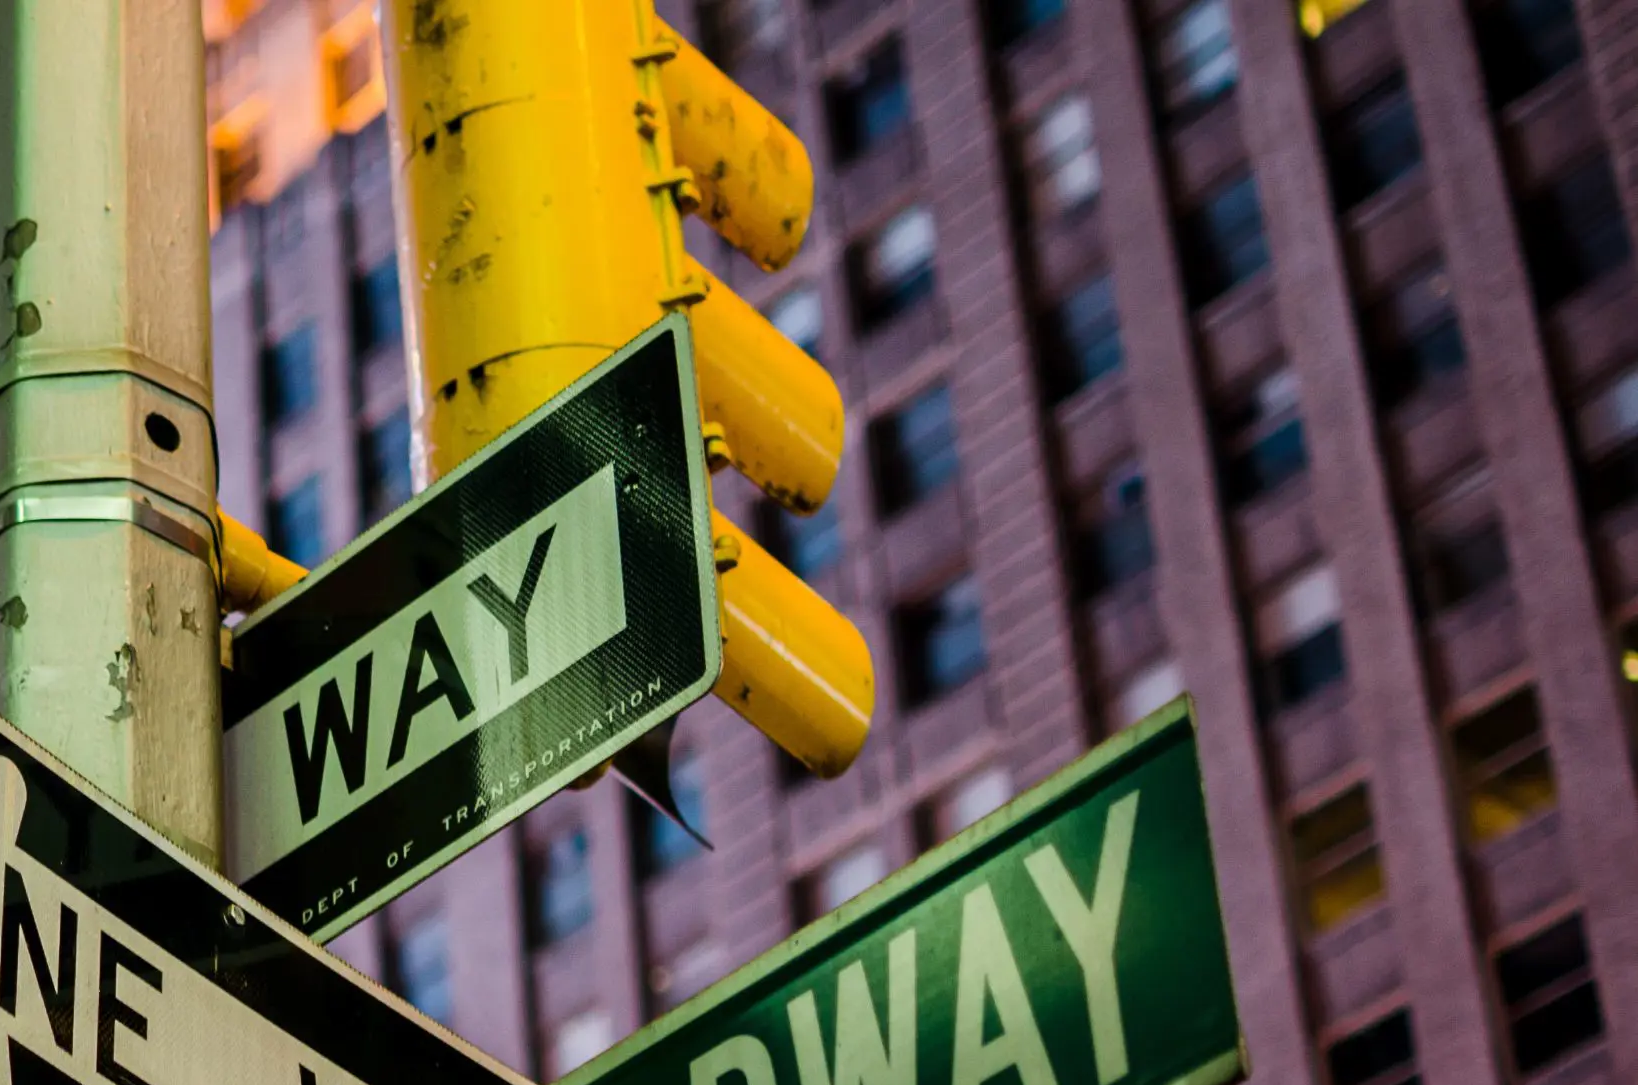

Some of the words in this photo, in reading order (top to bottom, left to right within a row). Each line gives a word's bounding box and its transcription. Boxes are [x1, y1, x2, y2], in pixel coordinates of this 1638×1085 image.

[283, 522, 558, 827] WAY
[302, 877, 359, 925] DEPT
[386, 840, 414, 868] OF
[442, 677, 662, 831] TRANSPORTATION
